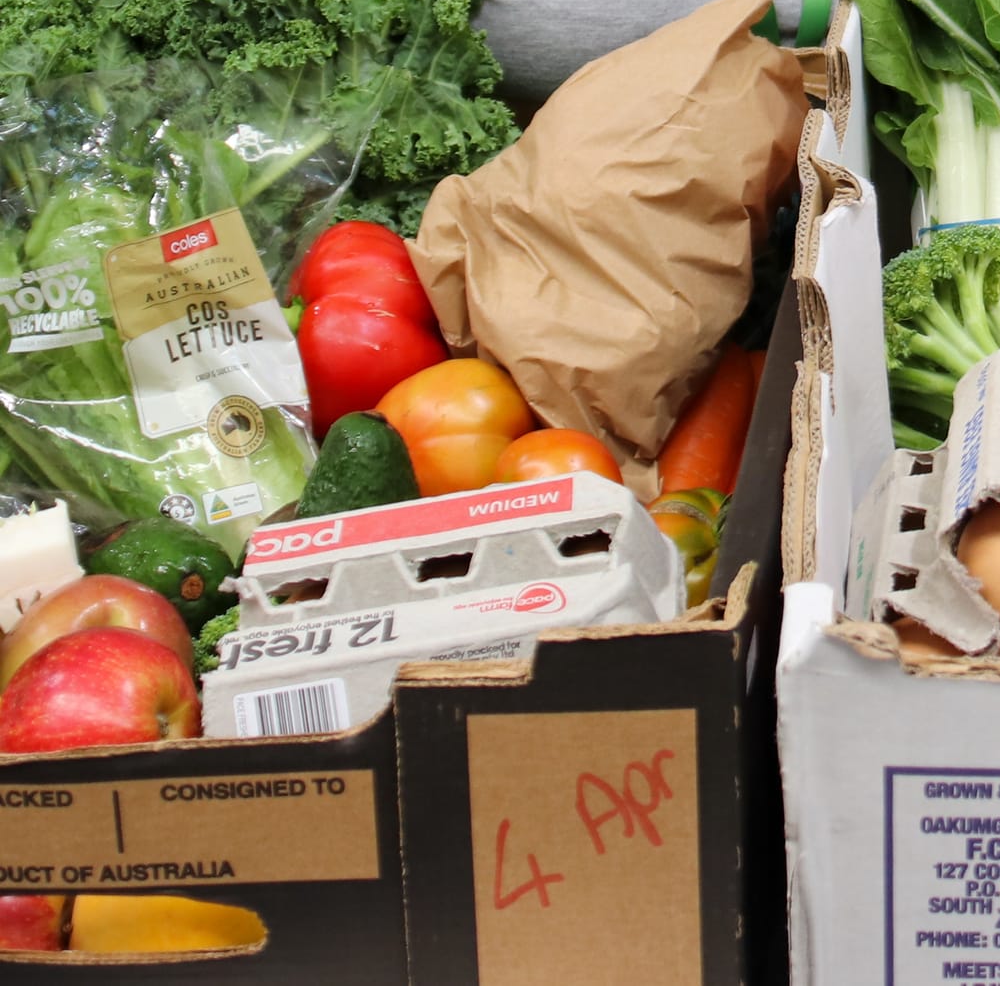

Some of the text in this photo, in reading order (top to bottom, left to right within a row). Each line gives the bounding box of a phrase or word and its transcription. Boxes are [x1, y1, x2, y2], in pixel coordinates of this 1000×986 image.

[171, 231, 208, 254] coles
[0, 274, 96, 317] 100%
[145, 266, 251, 303] AUSTRALIAN
[8, 308, 100, 337] RECYCLABLE
[187, 300, 230, 327] COS
[164, 318, 263, 363] LETTUCE
[468, 490, 560, 517] MEDIUM
[515, 595, 553, 608] pace
[348, 616, 400, 649] 12
[160, 777, 346, 802] CONSIGNED TO
[924, 781, 993, 799] GROWN
[494, 749, 675, 910] 4 Apr
[61, 864, 94, 883] OF
[100, 859, 236, 882] AUSTRALIA
[934, 862, 968, 879] 127
[966, 881, 1000, 897] P.O.
[928, 897, 993, 914] SOUTH
[916, 931, 988, 948] PHONE:
